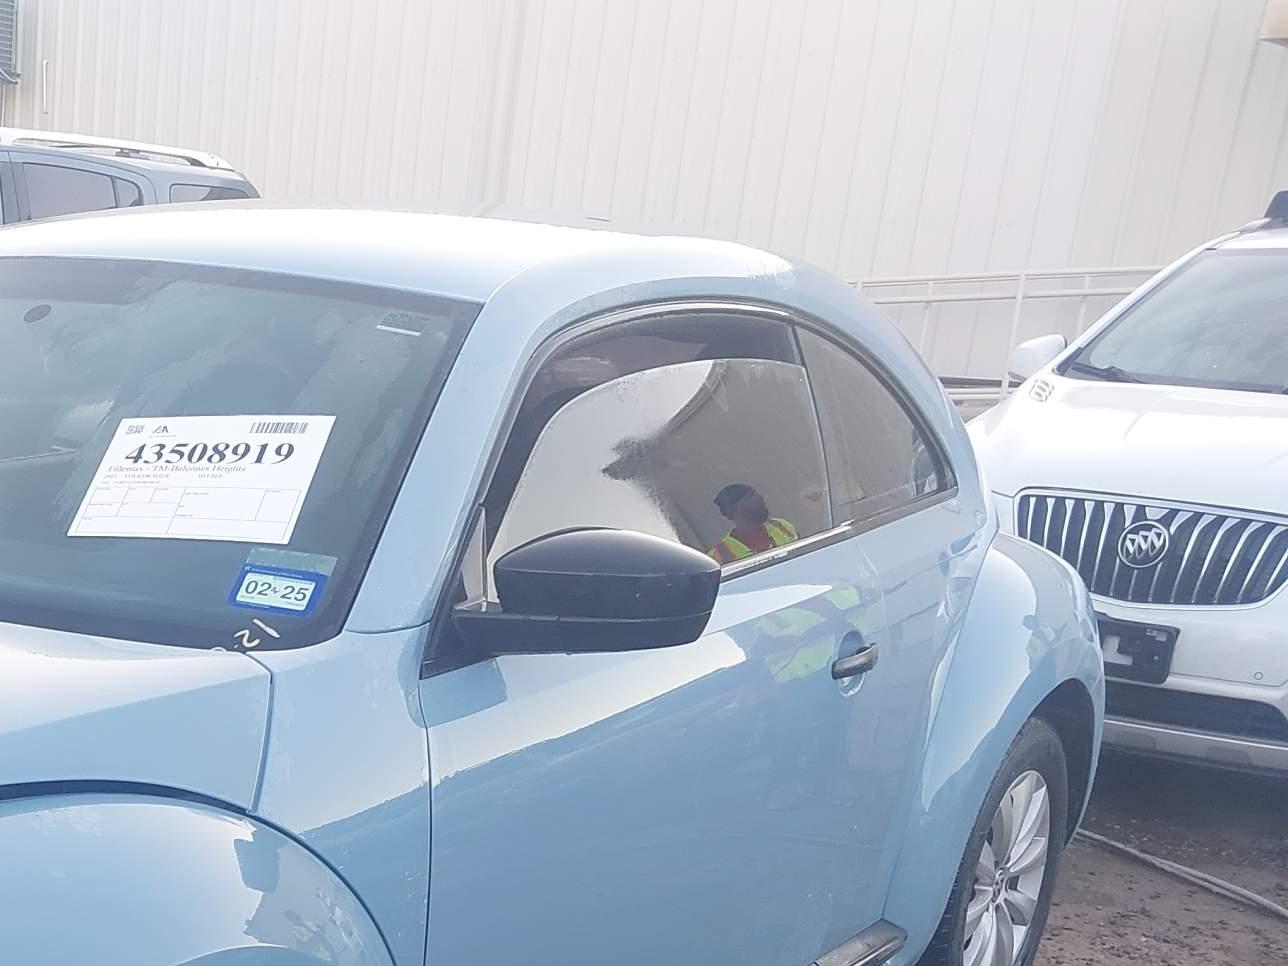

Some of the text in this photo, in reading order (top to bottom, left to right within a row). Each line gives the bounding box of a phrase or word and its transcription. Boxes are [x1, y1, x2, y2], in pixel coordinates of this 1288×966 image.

[124, 442, 295, 465] 43508919
[212, 464, 247, 474] Heights
[245, 580, 309, 602] 02 25
